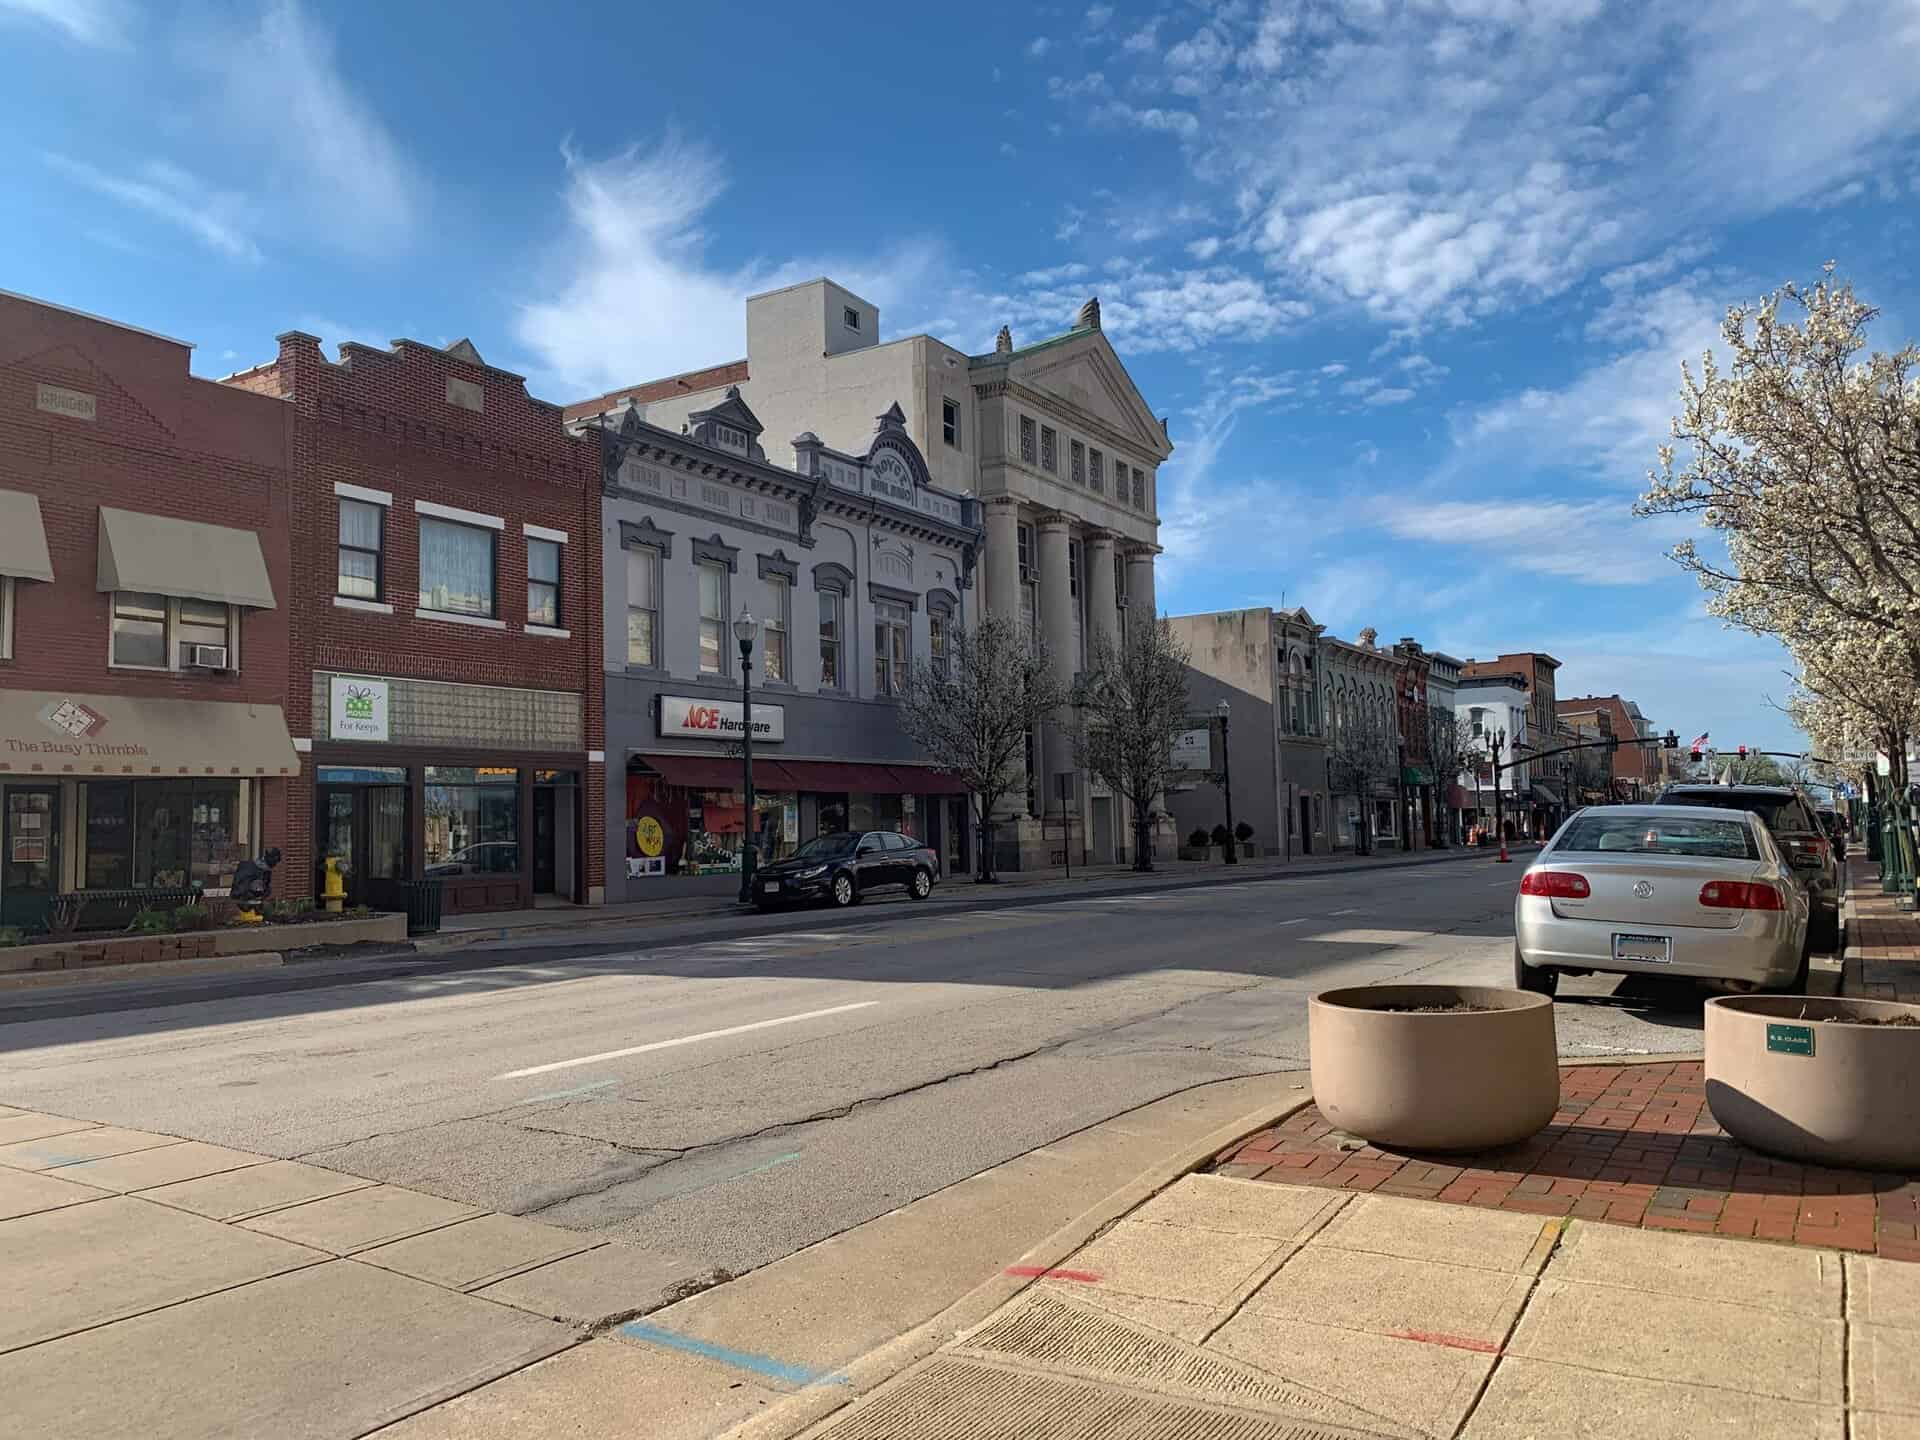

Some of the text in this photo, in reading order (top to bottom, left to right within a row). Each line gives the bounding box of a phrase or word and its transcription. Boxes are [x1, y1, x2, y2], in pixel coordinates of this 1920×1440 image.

[681, 703, 721, 729] ACE
[339, 720, 380, 735] For Keeps
[5, 738, 149, 756] The Busy Thimble
